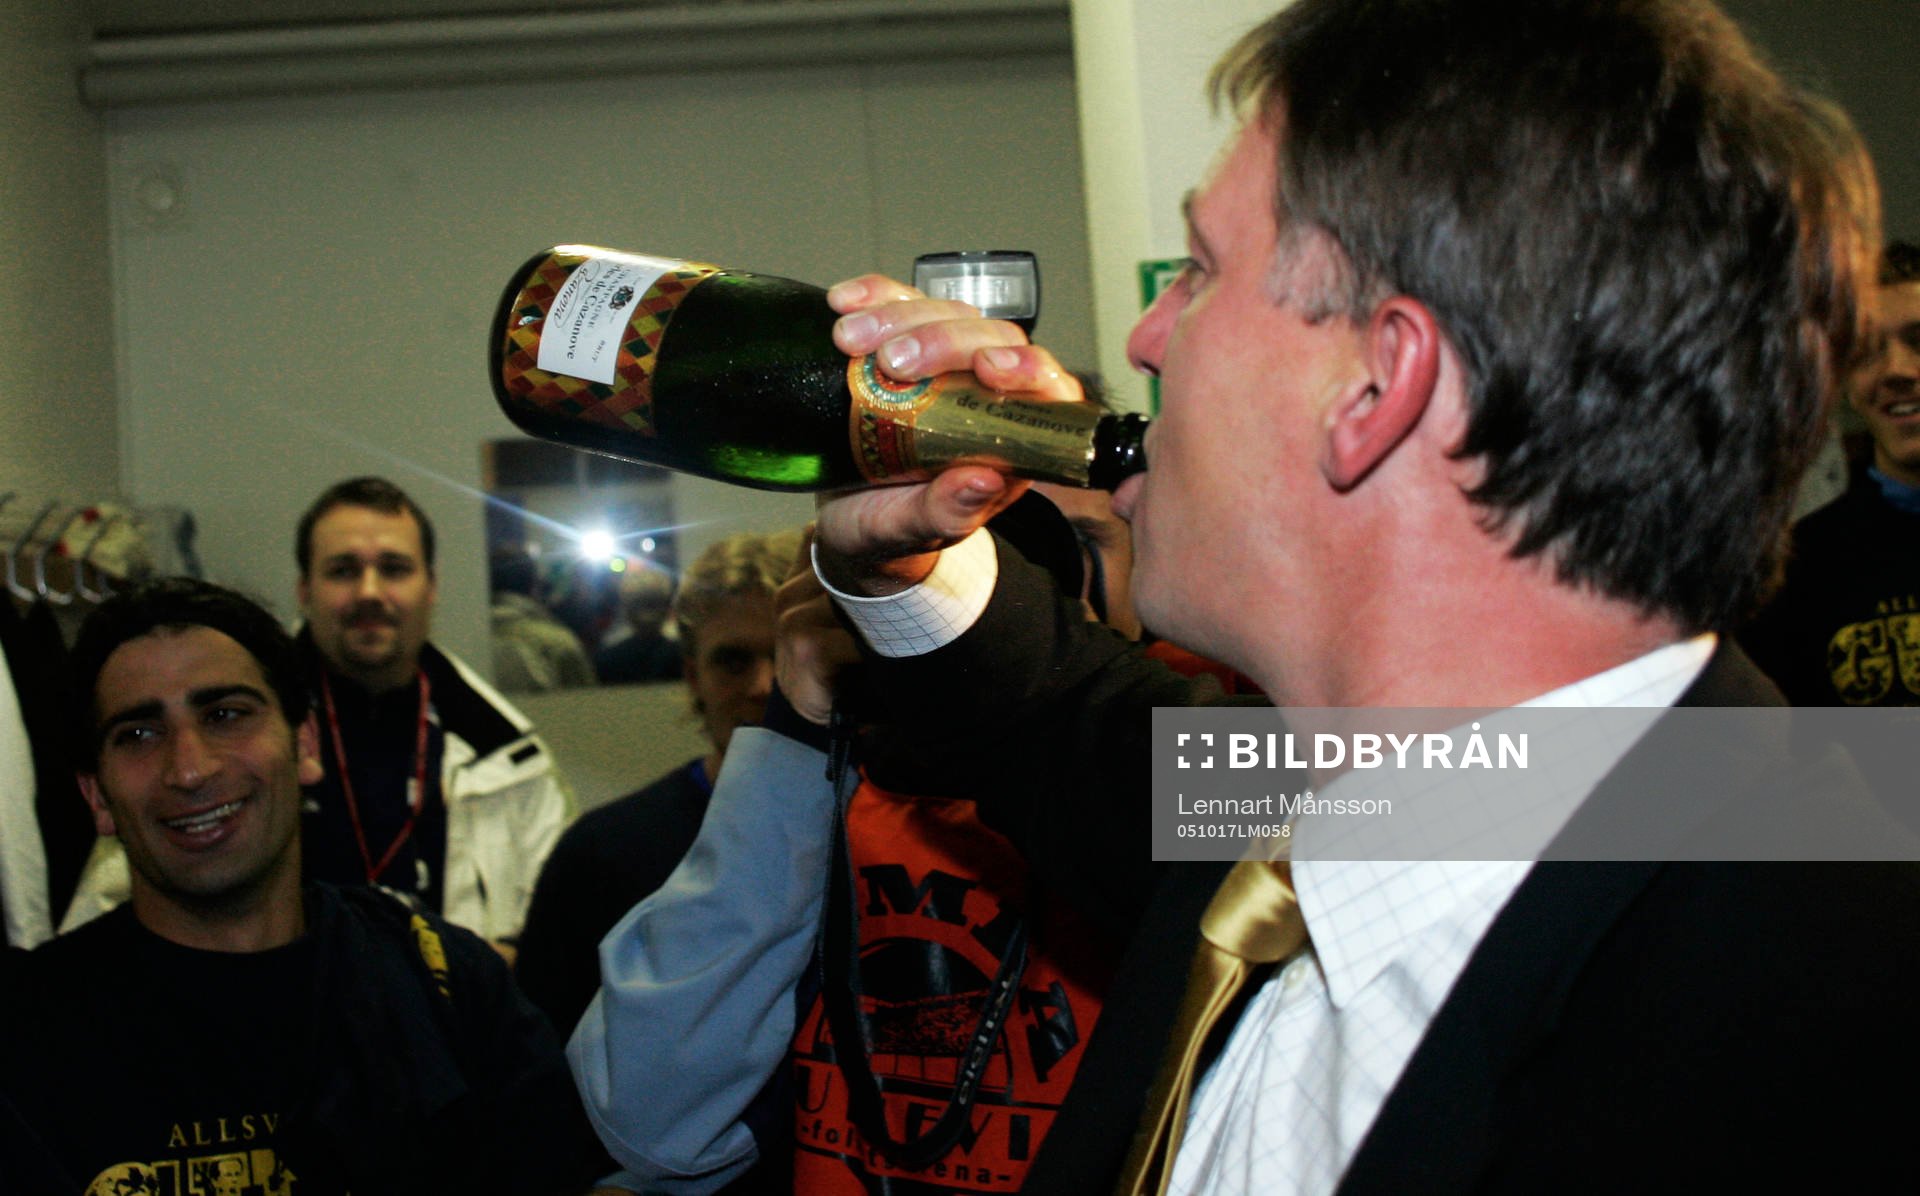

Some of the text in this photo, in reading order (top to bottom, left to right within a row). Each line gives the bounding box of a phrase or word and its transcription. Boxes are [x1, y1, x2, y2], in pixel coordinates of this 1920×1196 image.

[592, 281, 606, 293] de
[566, 295, 598, 360] Cazanove
[957, 395, 978, 411] de
[986, 402, 1087, 437] Cazanove
